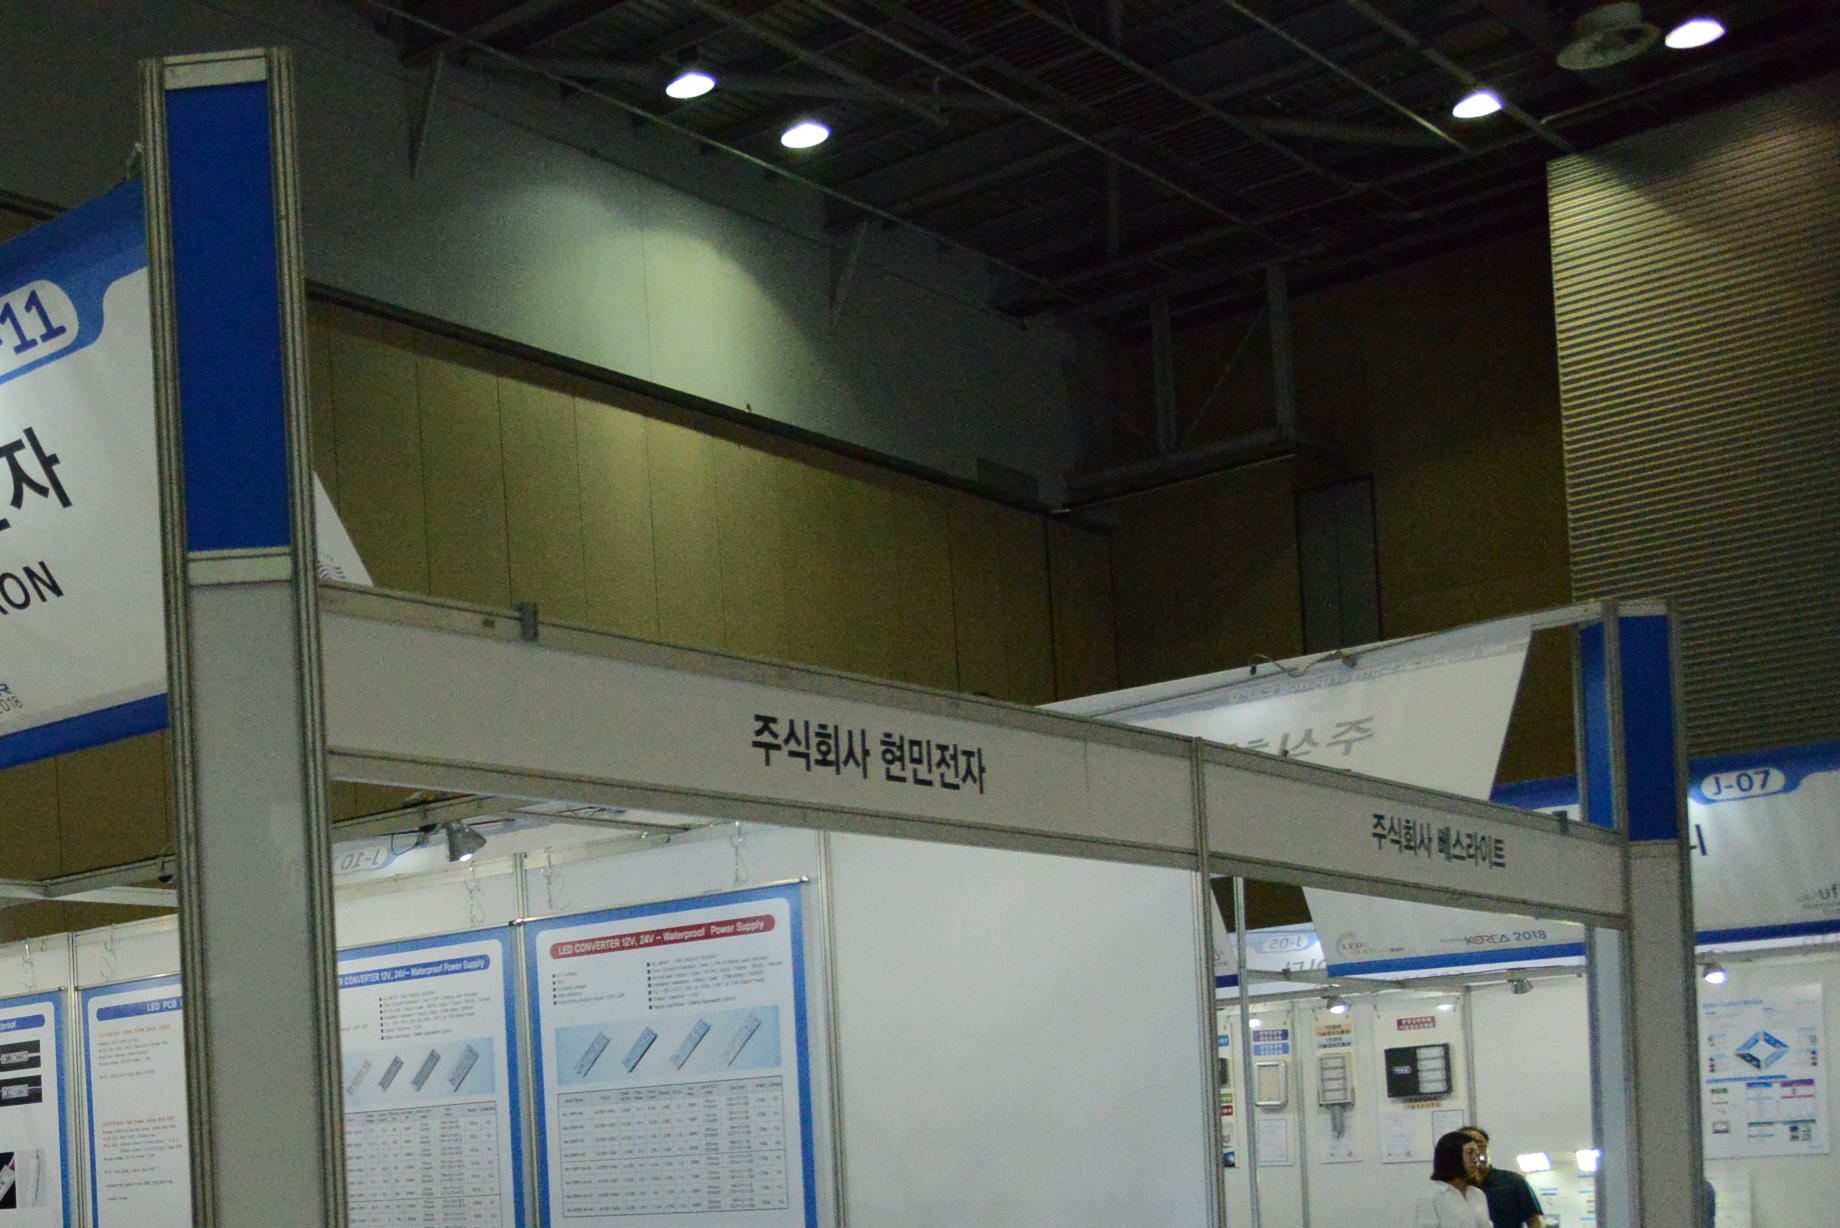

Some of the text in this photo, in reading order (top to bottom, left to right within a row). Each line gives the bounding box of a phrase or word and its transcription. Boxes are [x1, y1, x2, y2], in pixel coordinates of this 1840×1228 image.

[752, 713, 986, 795] 주식회사 현민전자
[1711, 769, 1771, 796] J-07
[1371, 812, 1433, 859] 주식회사
[1817, 883, 1840, 901] uf
[558, 943, 573, 956] LED
[574, 938, 620, 954] CONVERTER
[662, 925, 706, 942] Waterproof
[710, 924, 735, 936] Power
[736, 919, 765, 934] Supply
[1513, 930, 1547, 942] 2018
